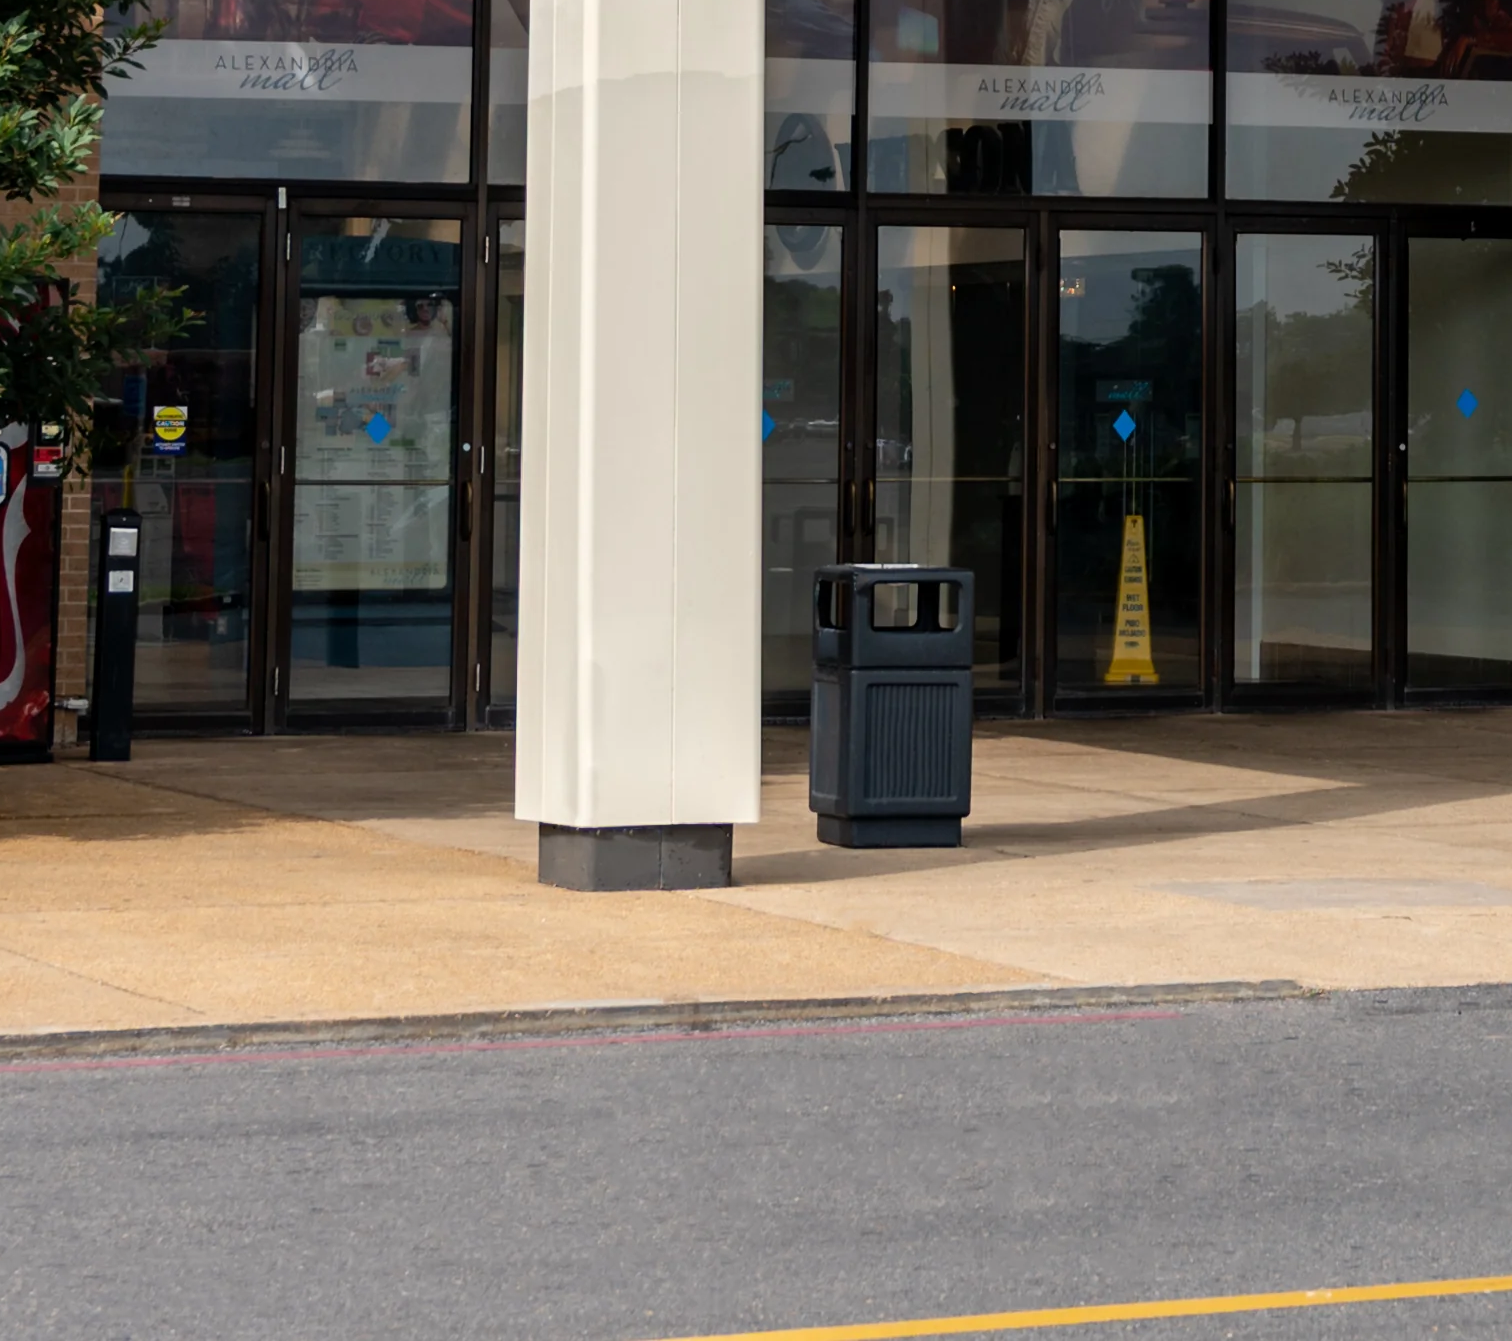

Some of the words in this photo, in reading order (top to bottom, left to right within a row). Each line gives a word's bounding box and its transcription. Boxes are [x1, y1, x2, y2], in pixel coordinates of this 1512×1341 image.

[215, 55, 358, 73] ALEXANDRIA
[240, 49, 354, 91] mall
[978, 78, 1105, 96] ALEXANDRIA
[1000, 73, 1101, 112] mall
[1328, 88, 1449, 106] ALEXANDRIA
[1349, 84, 1445, 122] mall
